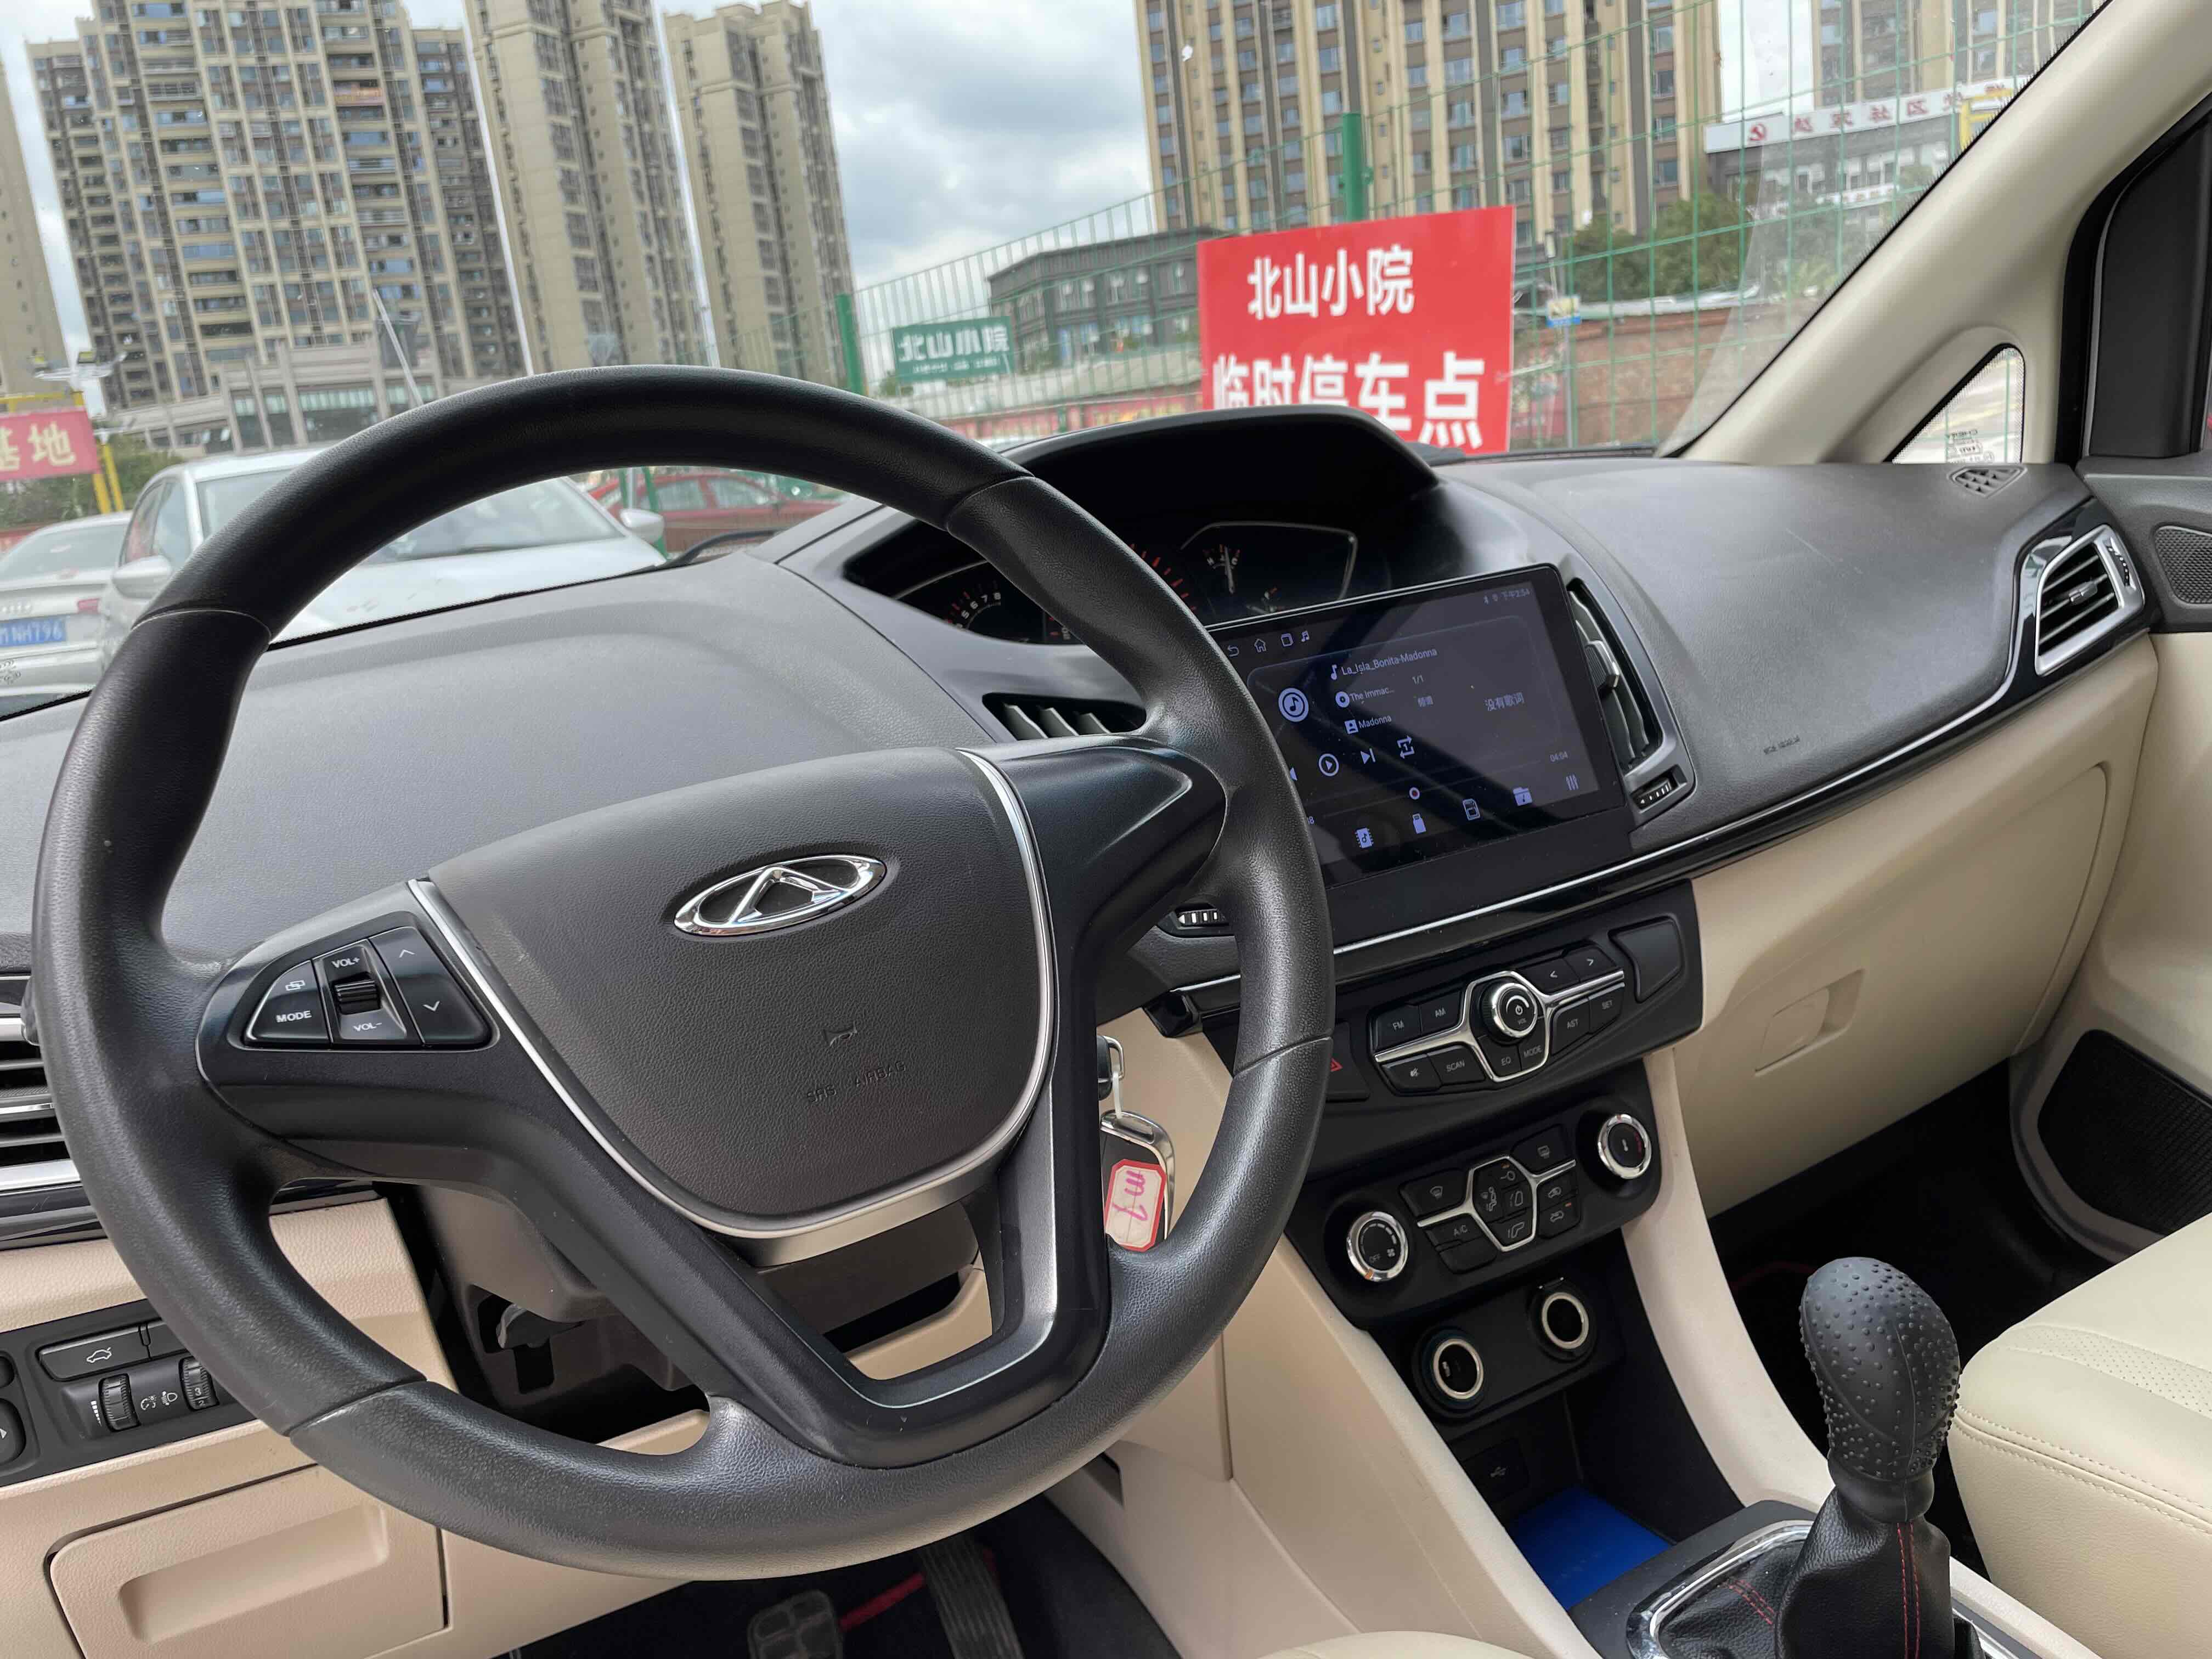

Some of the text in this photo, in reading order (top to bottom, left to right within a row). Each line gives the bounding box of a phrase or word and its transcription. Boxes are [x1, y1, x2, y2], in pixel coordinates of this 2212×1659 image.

[1247, 244, 1415, 320] 北山小院
[1212, 351, 1485, 449] 临时停车点
[962, 592, 1001, 619] 5 6 7 8
[1412, 674, 1424, 685] 1/1
[1350, 691, 1364, 702] The
[1358, 715, 1392, 729] Madonna
[332, 956, 360, 968] VOL+
[1601, 1000, 1612, 1009] SET
[276, 1010, 312, 1023] MODE
[1435, 1007, 1446, 1017] AM
[353, 1022, 382, 1032] VOL-
[1392, 1020, 1404, 1031] FM
[1567, 1018, 1578, 1029] AST
[1523, 1045, 1542, 1058] MODE
[1446, 1060, 1465, 1071] SCAN
[856, 1061, 906, 1087] AIRBAG
[1454, 1224, 1468, 1236] A/C
[195, 1387, 201, 1396] 3
